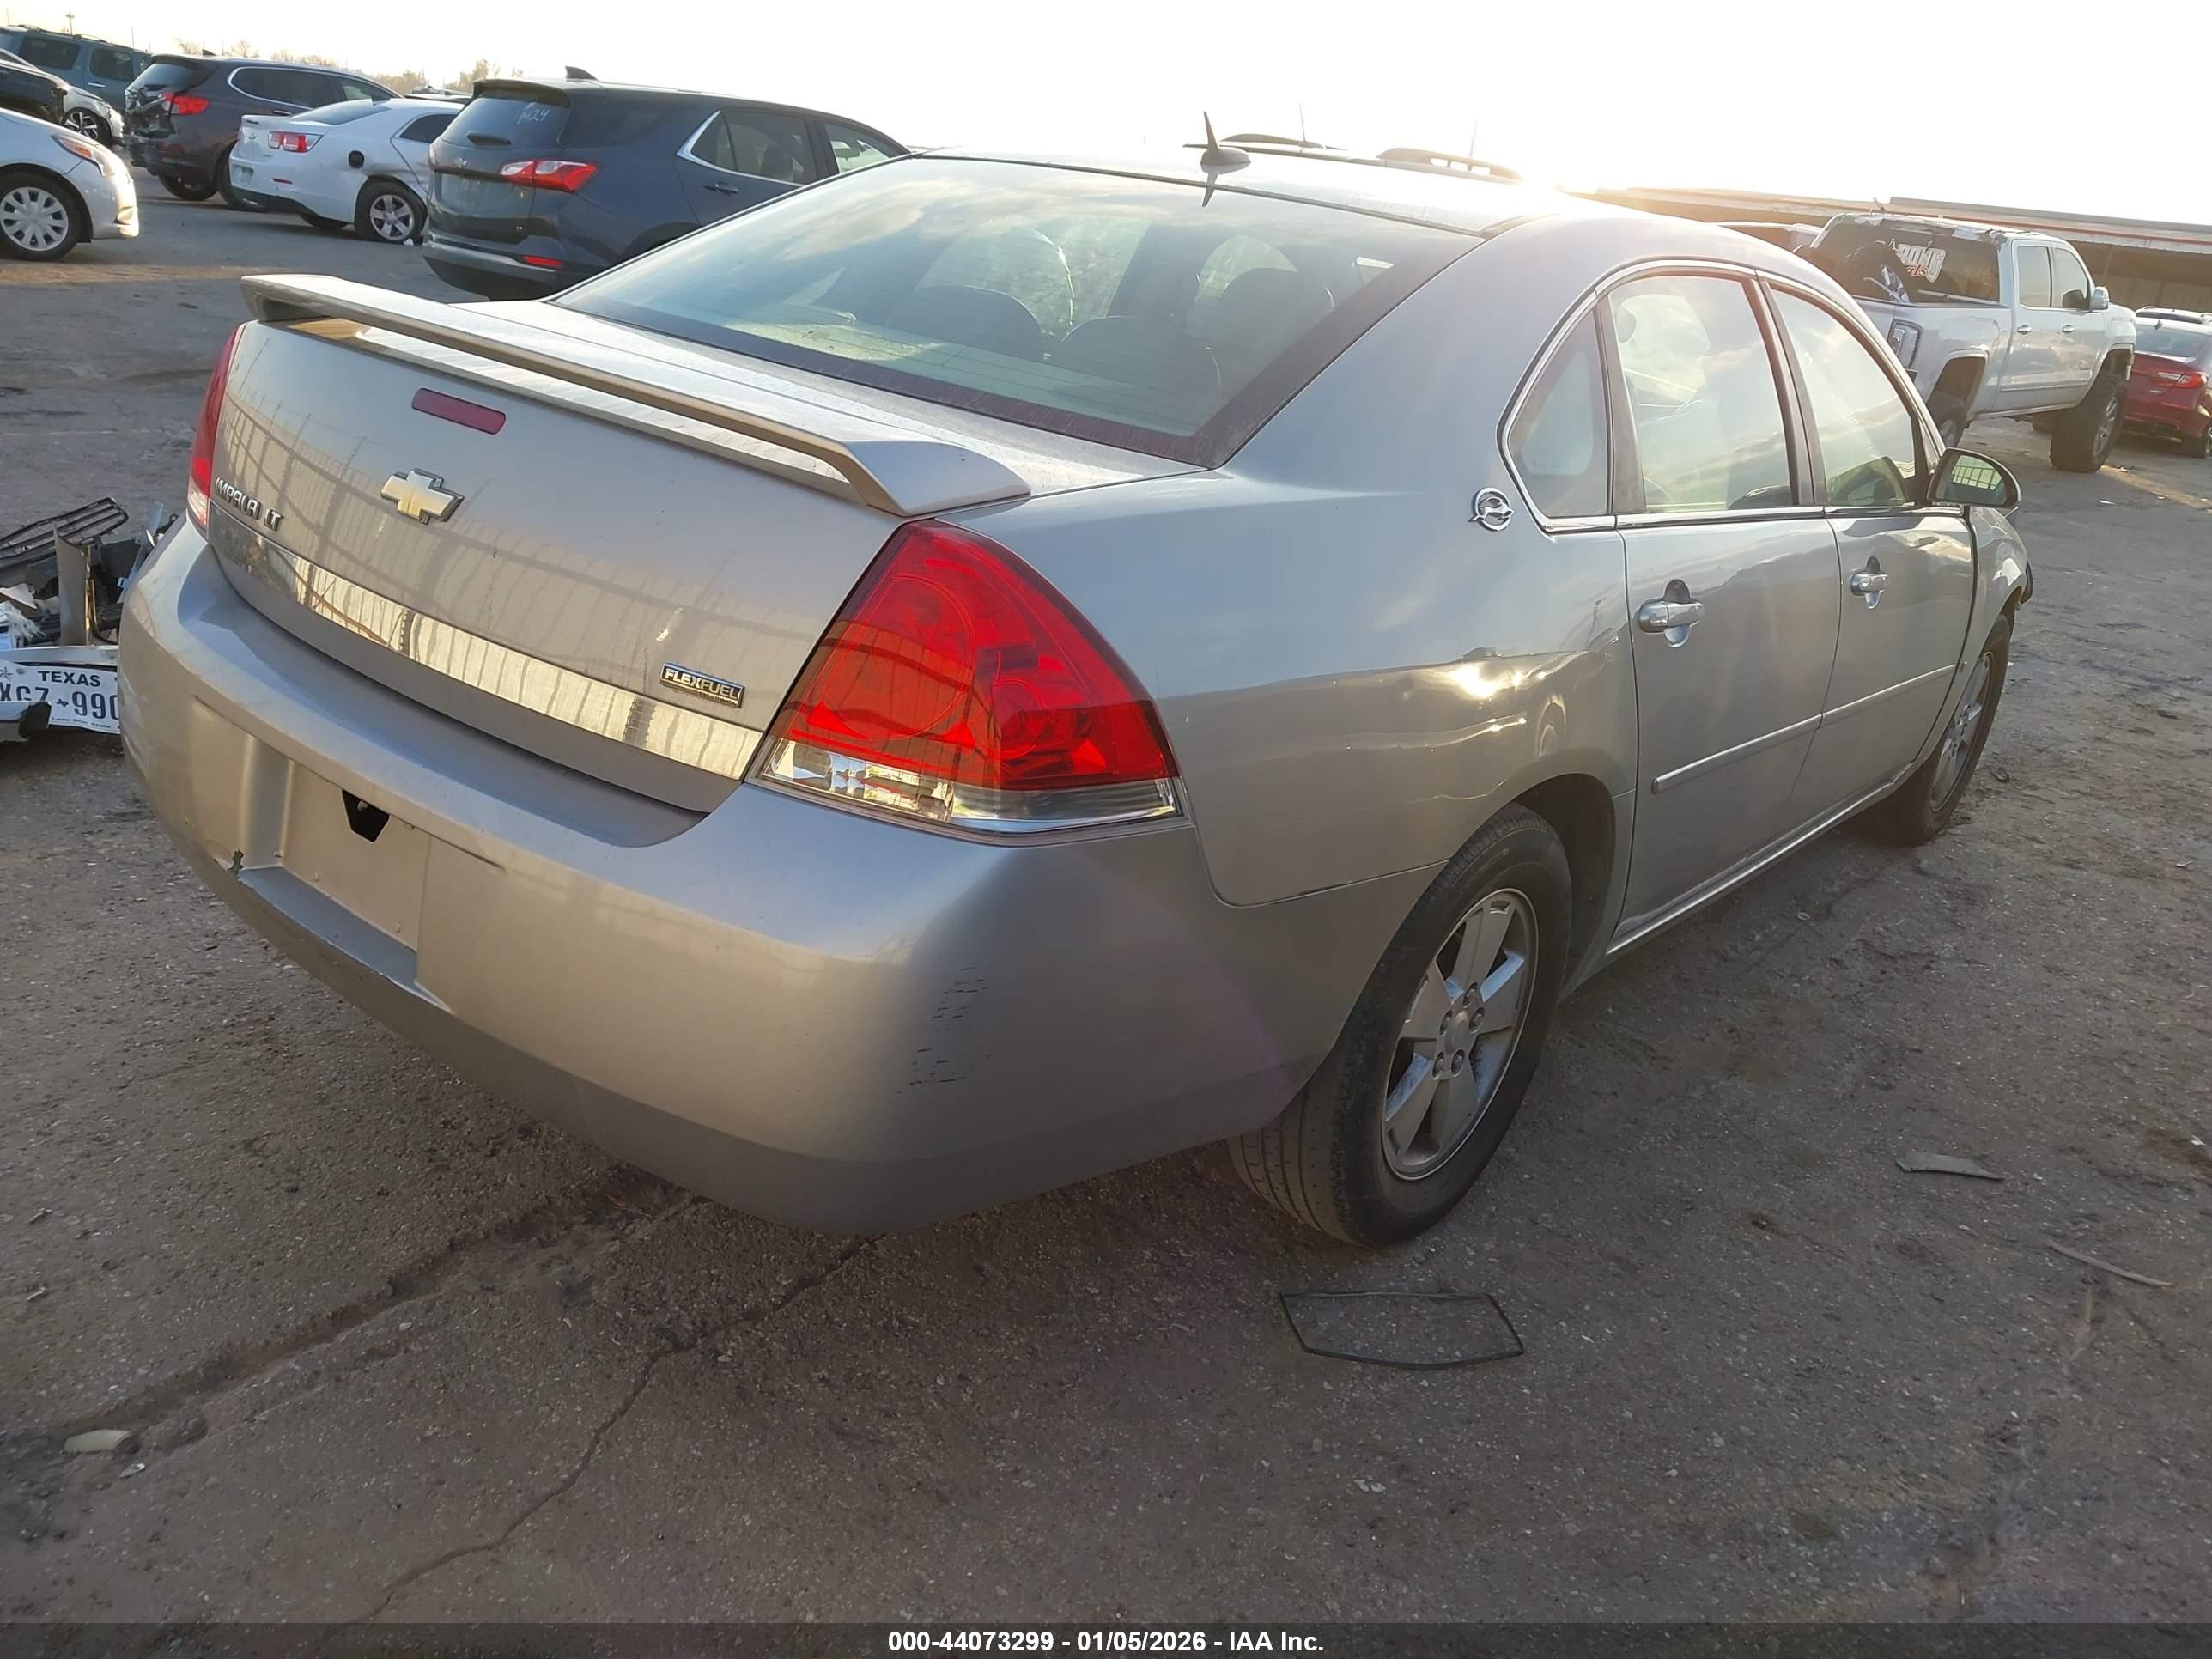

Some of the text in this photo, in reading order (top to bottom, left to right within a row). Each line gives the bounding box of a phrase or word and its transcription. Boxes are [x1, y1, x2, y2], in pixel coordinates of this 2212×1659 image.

[215, 477, 283, 532] IMPALA LT
[37, 670, 101, 687] TEXAS
[665, 667, 738, 700] FLEXFUEL
